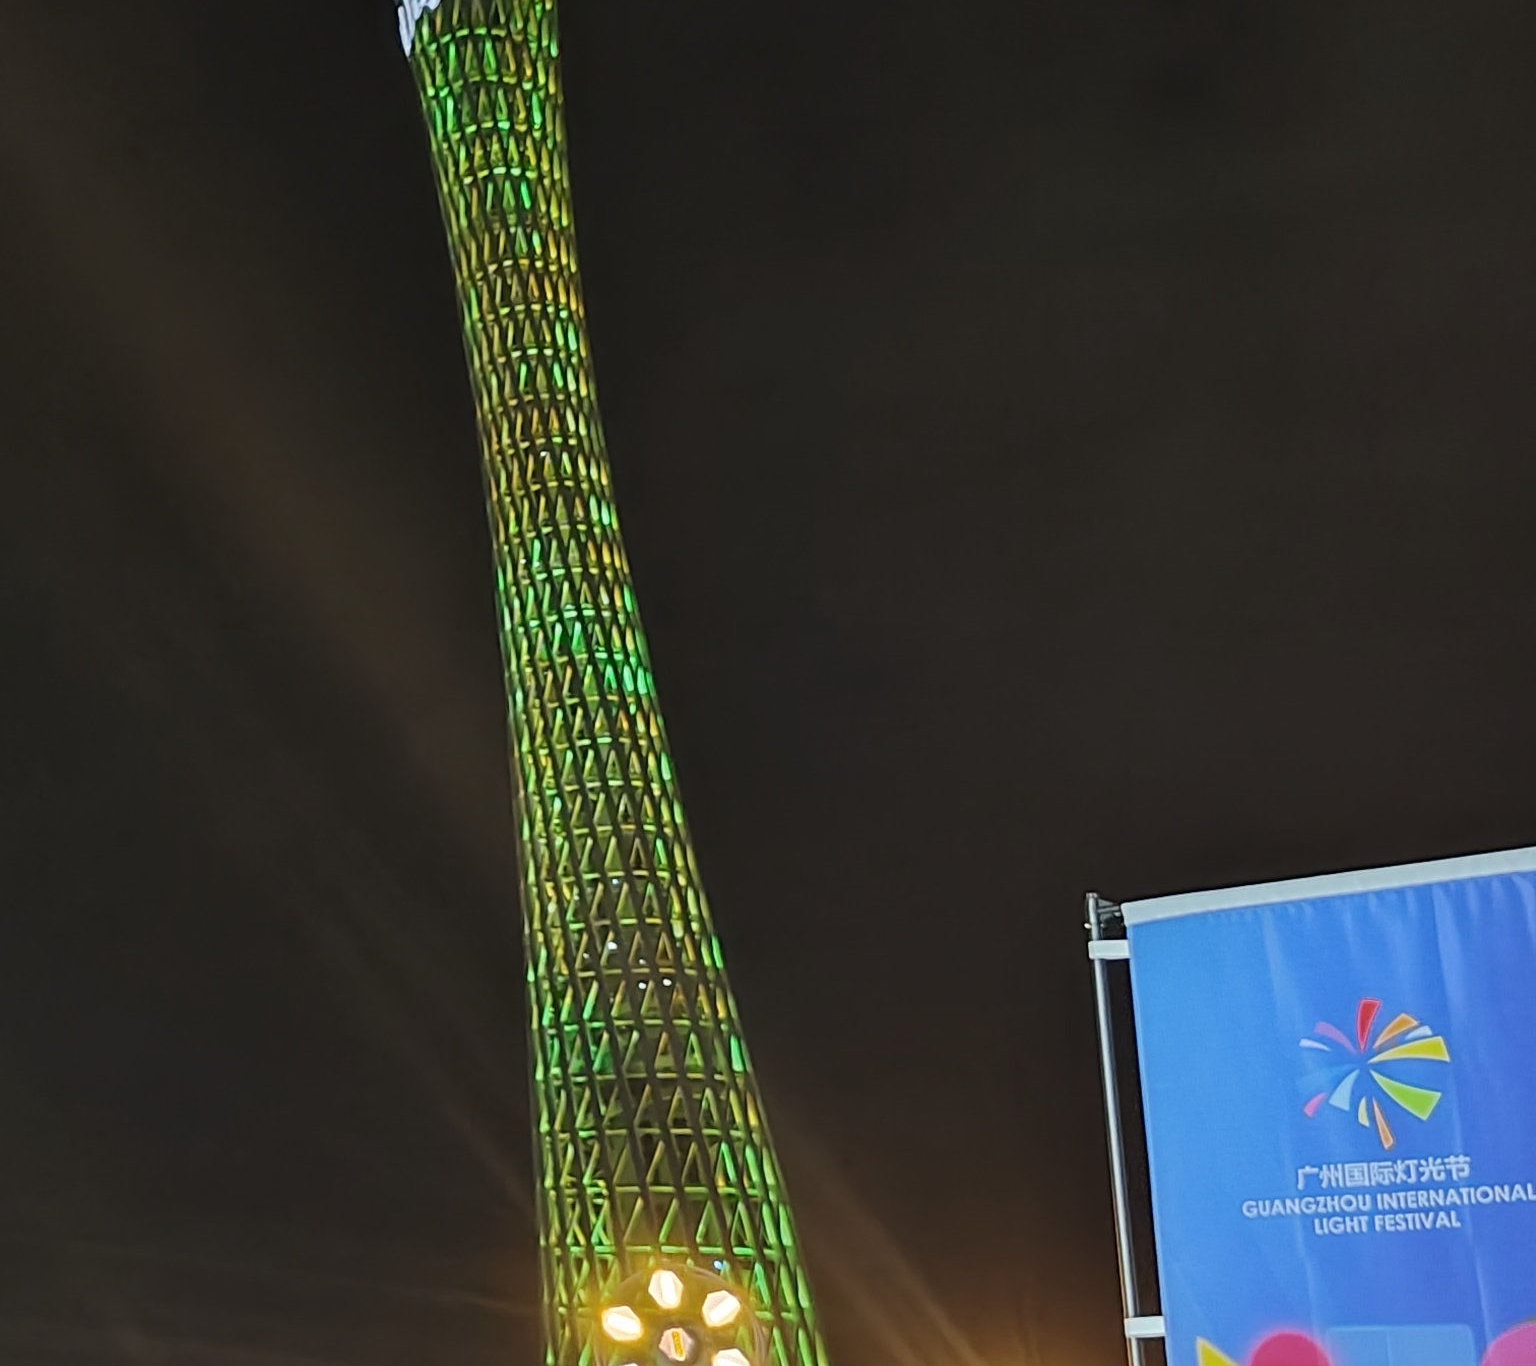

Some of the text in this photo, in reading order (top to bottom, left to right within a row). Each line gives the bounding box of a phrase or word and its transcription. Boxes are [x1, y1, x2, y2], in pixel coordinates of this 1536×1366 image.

[1297, 1154, 1471, 1190] 广州国际灯光节
[1242, 1182, 1536, 1218] GUANGZHOU INTERNATIONAL
[1314, 1210, 1461, 1235] LIGHT FESTIVAL
